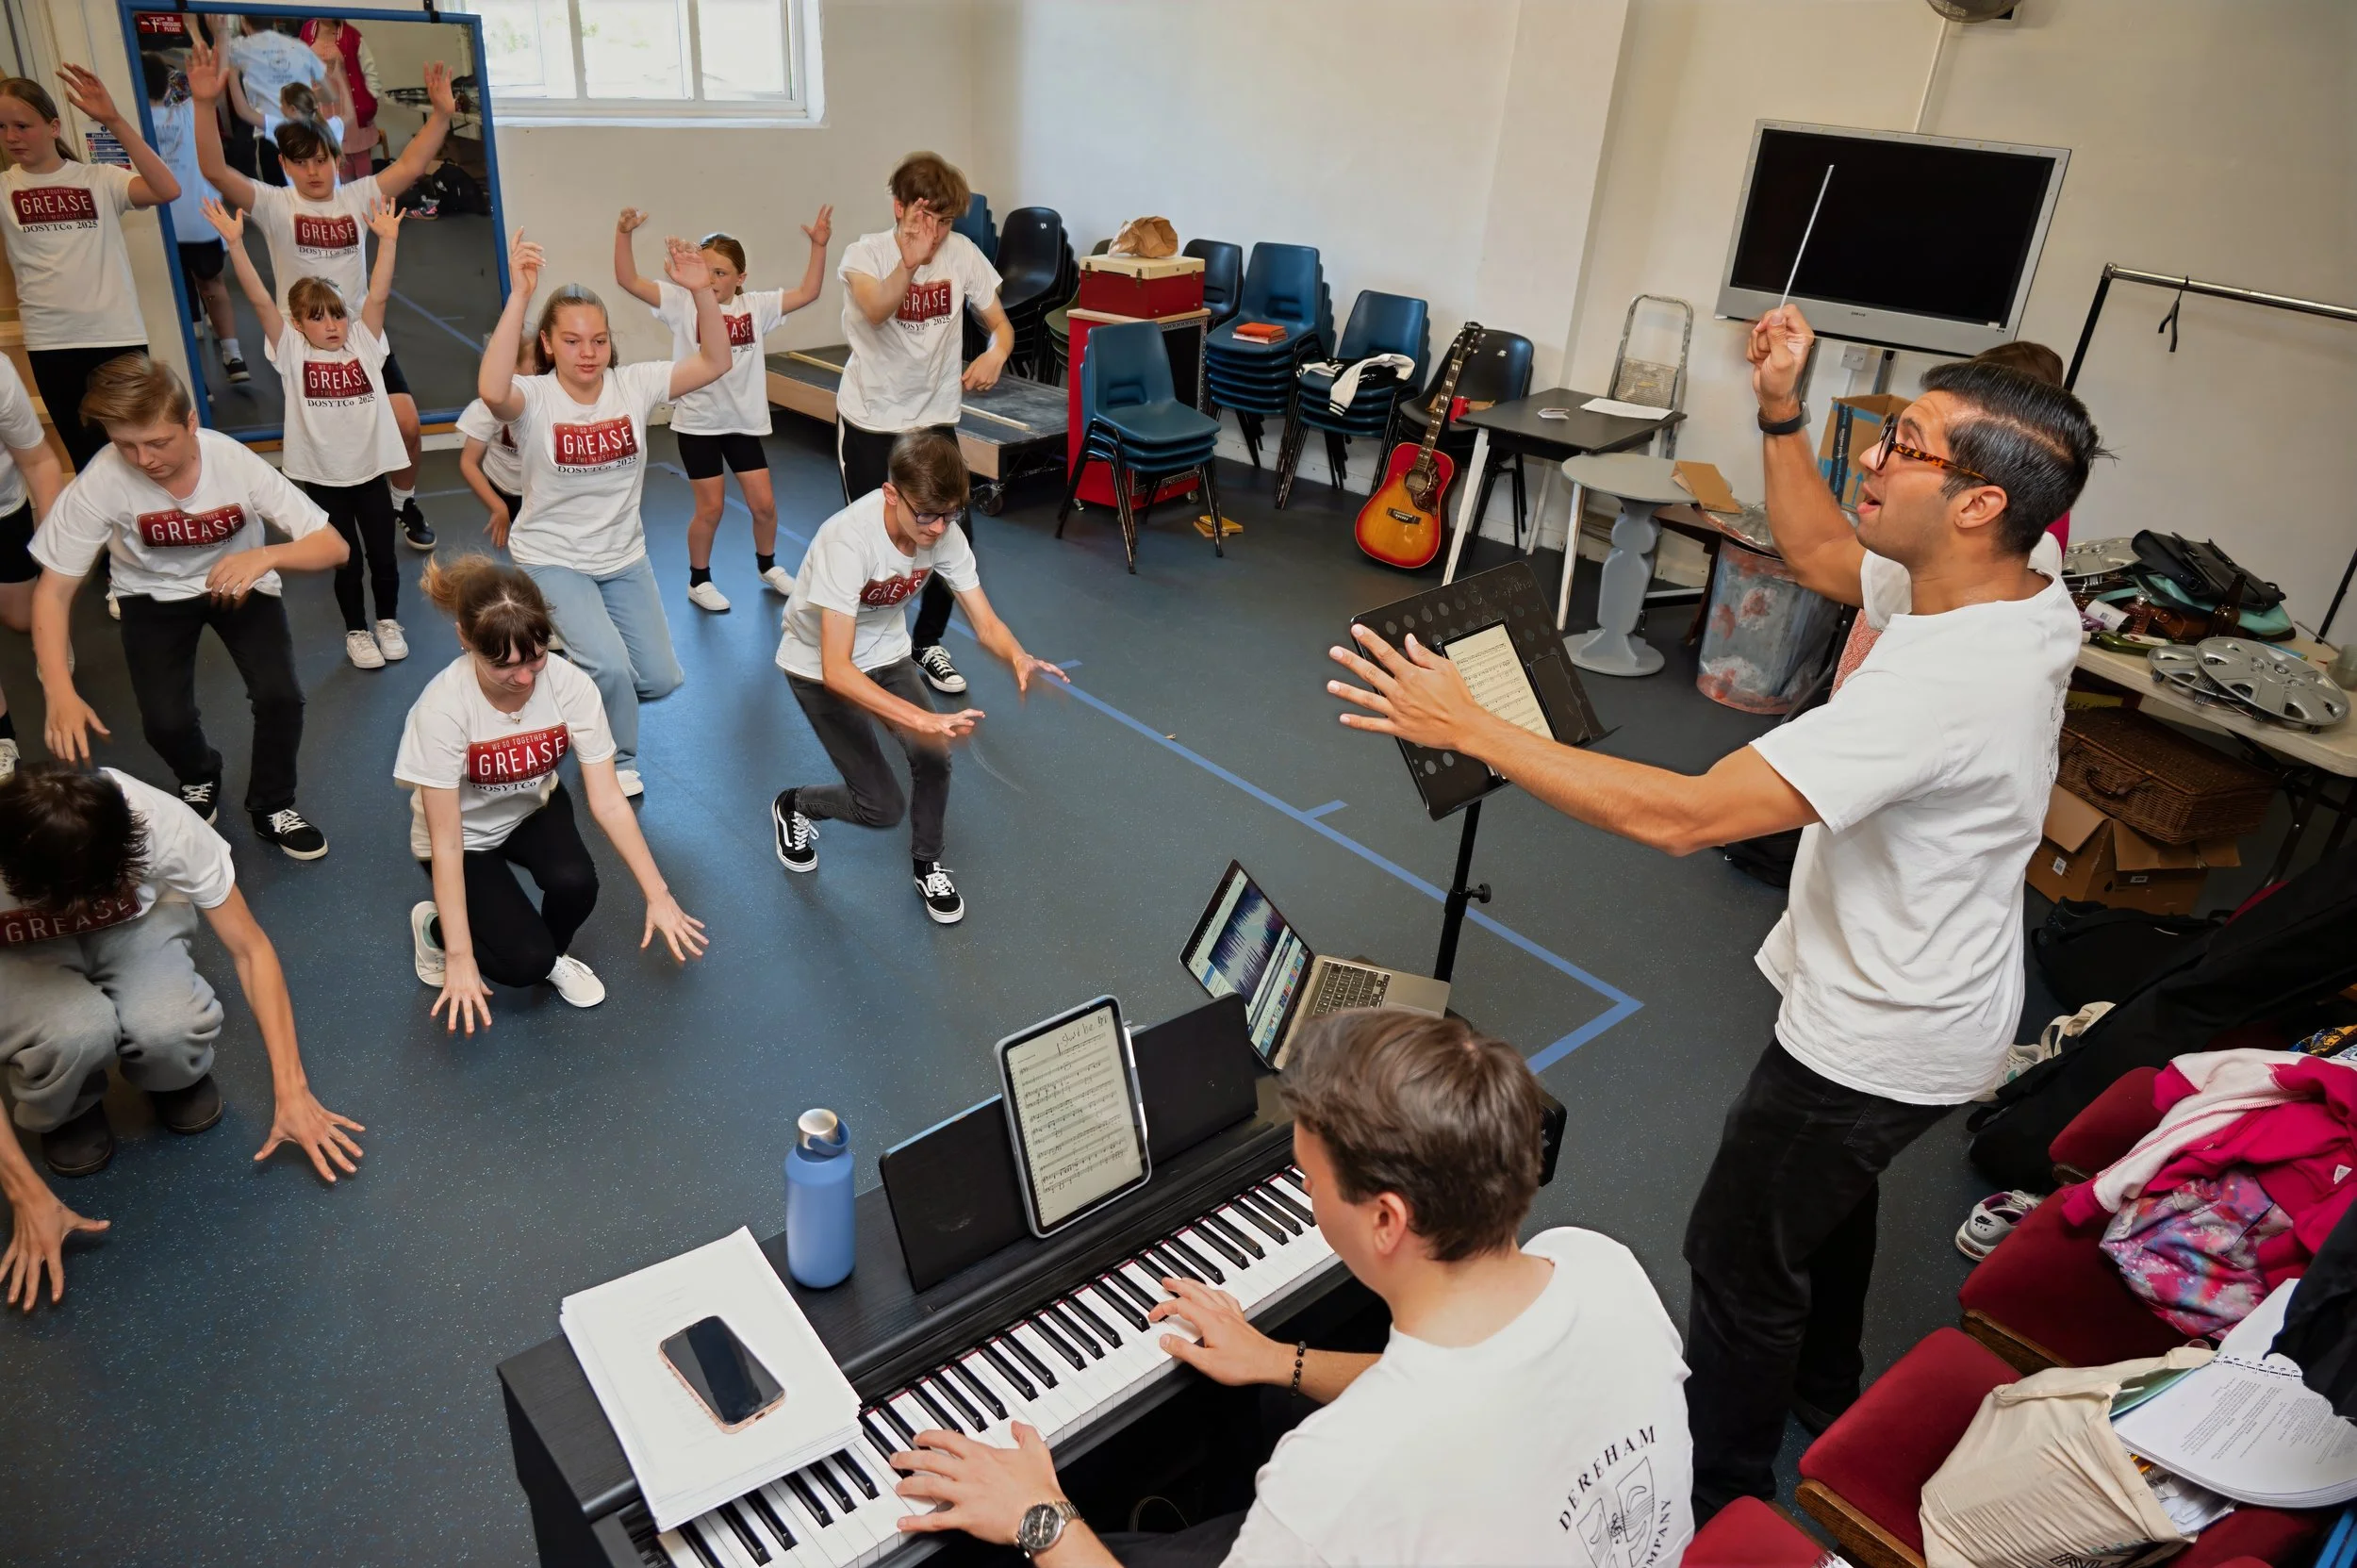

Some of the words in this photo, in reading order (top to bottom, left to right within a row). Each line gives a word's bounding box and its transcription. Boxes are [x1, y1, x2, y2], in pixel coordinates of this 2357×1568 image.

[21, 194, 91, 215] GREASE
[23, 223, 73, 233] DOSYTCo
[76, 221, 99, 229] 2025
[302, 222, 355, 240] GREASE
[343, 245, 359, 255] 2025
[933, 316, 951, 326] 2025
[307, 399, 354, 407] DOSYTCo
[358, 394, 375, 404] 2025
[563, 426, 633, 455] GREASE
[591, 452, 623, 463] MUSICAL
[616, 454, 637, 468] 2025
[151, 515, 239, 541] GREASE
[503, 740, 510, 749] GO
[512, 733, 548, 746] TOGETHER
[479, 736, 566, 776] GREASE
[514, 765, 551, 781] MUSICAL
[1558, 1425, 1656, 1532] DEREHAM
[1642, 1499, 1673, 1568] MPANY
